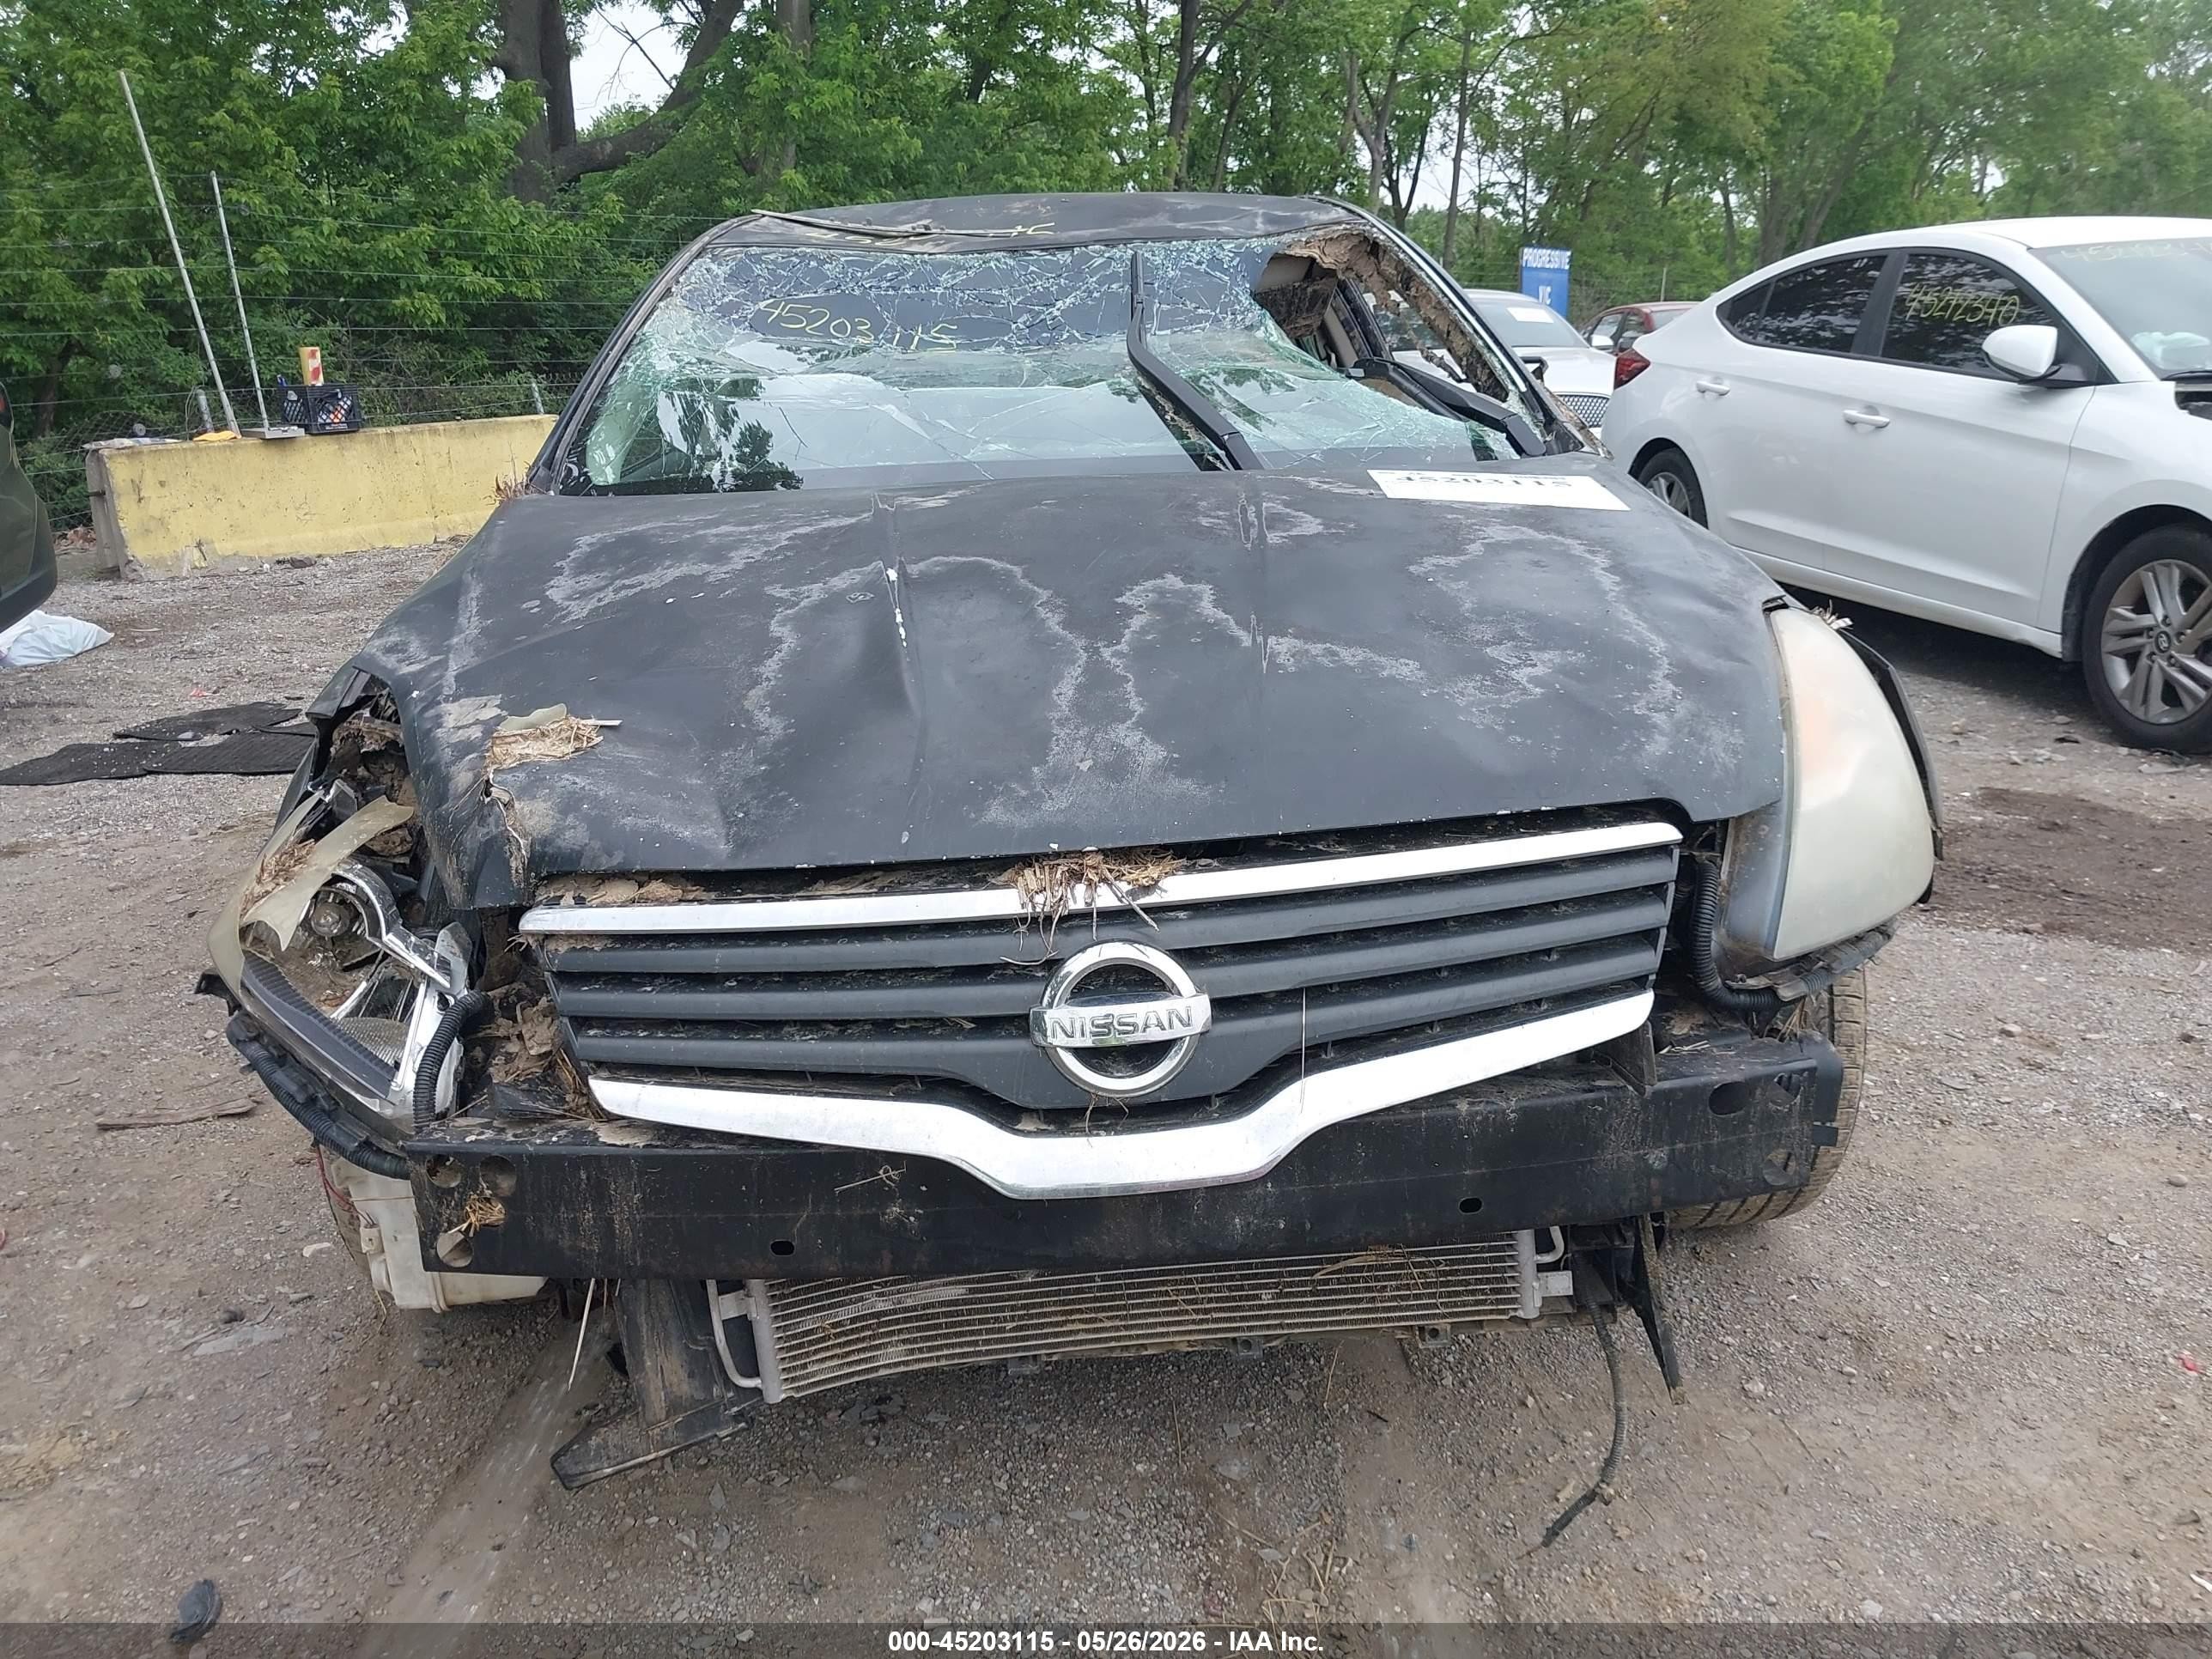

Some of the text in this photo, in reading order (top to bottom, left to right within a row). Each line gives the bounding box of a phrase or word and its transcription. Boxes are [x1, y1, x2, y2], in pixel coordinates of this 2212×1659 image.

[1522, 247, 1571, 270] PROGRESSIVE
[760, 300, 958, 351] 45203115
[1049, 1006, 1194, 1040] NISSAN
